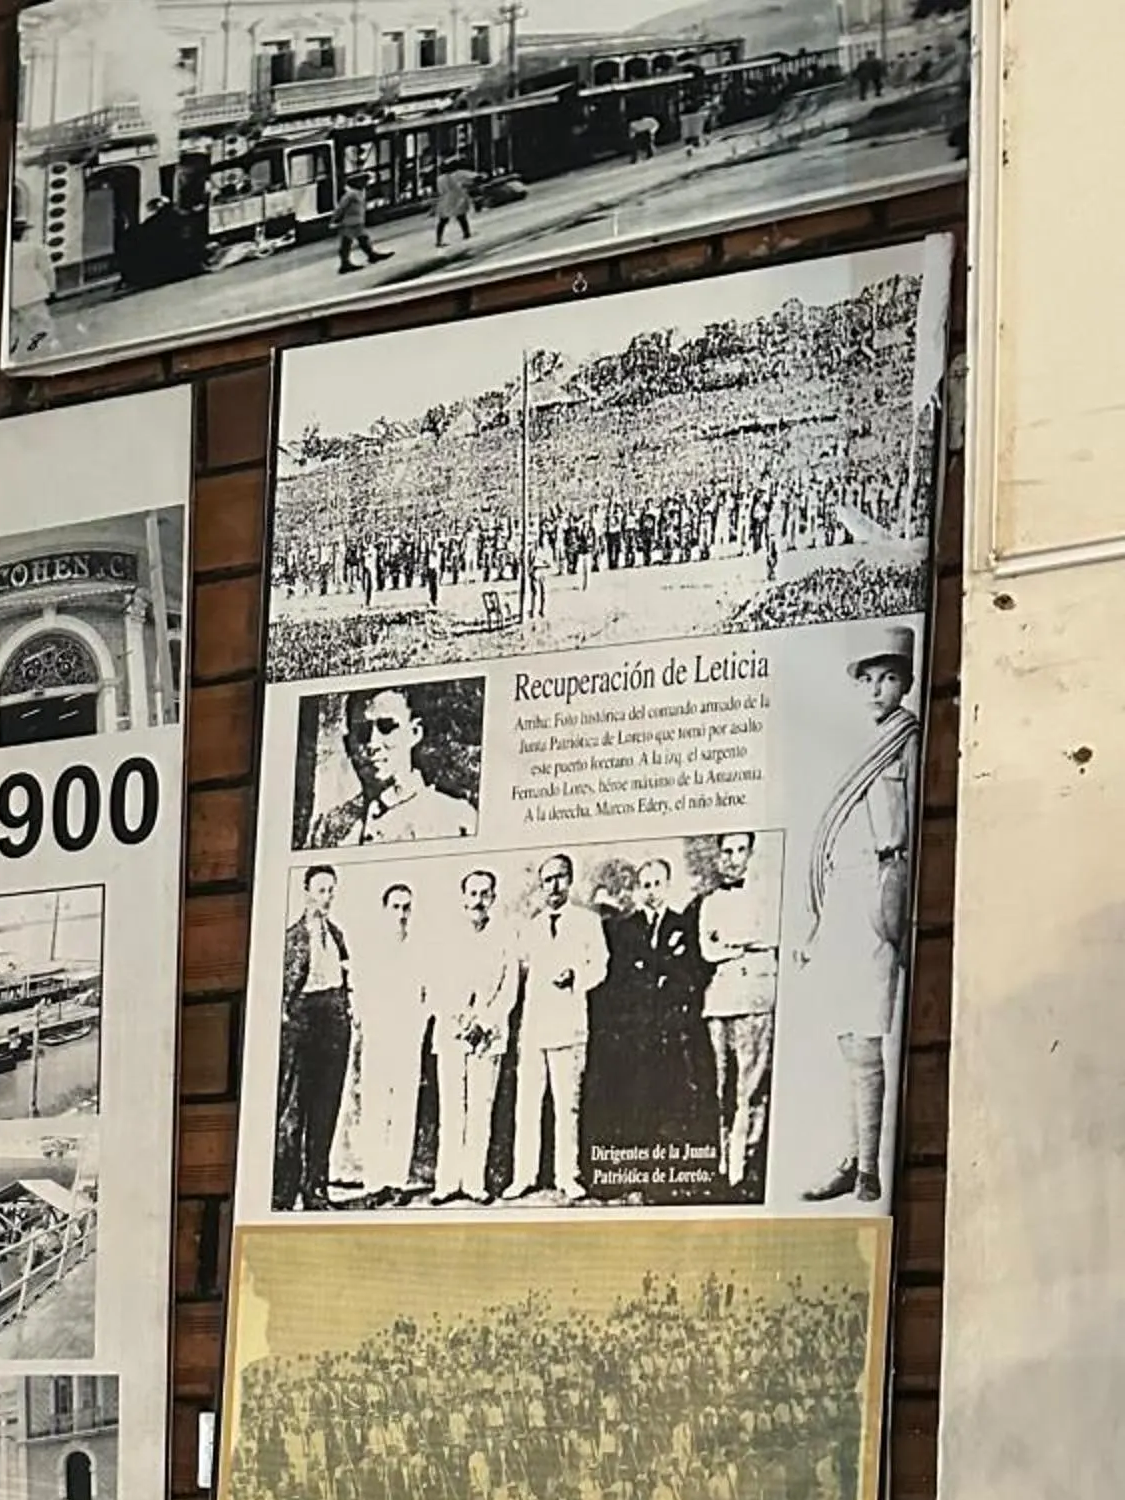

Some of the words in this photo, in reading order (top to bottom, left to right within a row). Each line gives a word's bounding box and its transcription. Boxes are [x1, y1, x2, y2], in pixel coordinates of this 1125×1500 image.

[515, 660, 655, 704] Recuperación
[662, 657, 687, 687] de
[694, 649, 769, 684] Leticia
[628, 703, 646, 720] del
[648, 699, 697, 719] comando
[700, 695, 741, 714] armado
[743, 694, 757, 709] de
[759, 692, 770, 708] la
[602, 730, 615, 747] de
[618, 729, 653, 745] Loreto
[655, 728, 675, 745] que
[709, 722, 727, 742] por
[730, 716, 763, 735] asalto
[639, 751, 649, 766] A
[652, 749, 662, 765] la
[687, 746, 698, 763] el
[701, 744, 748, 765] sargento
[512, 781, 559, 800] Fernando
[677, 771, 691, 787] de
[693, 769, 704, 785] la
[523, 806, 534, 822] A
[536, 803, 546, 821] la
[674, 794, 686, 811] el
[688, 793, 712, 810] niño
[590, 1144, 650, 1165] Dirigentes
[652, 1144, 666, 1160] de
[668, 1143, 680, 1159] la
[682, 1143, 717, 1161] Junta
[593, 1166, 649, 1185] Patriótica
[651, 1166, 666, 1184] de
